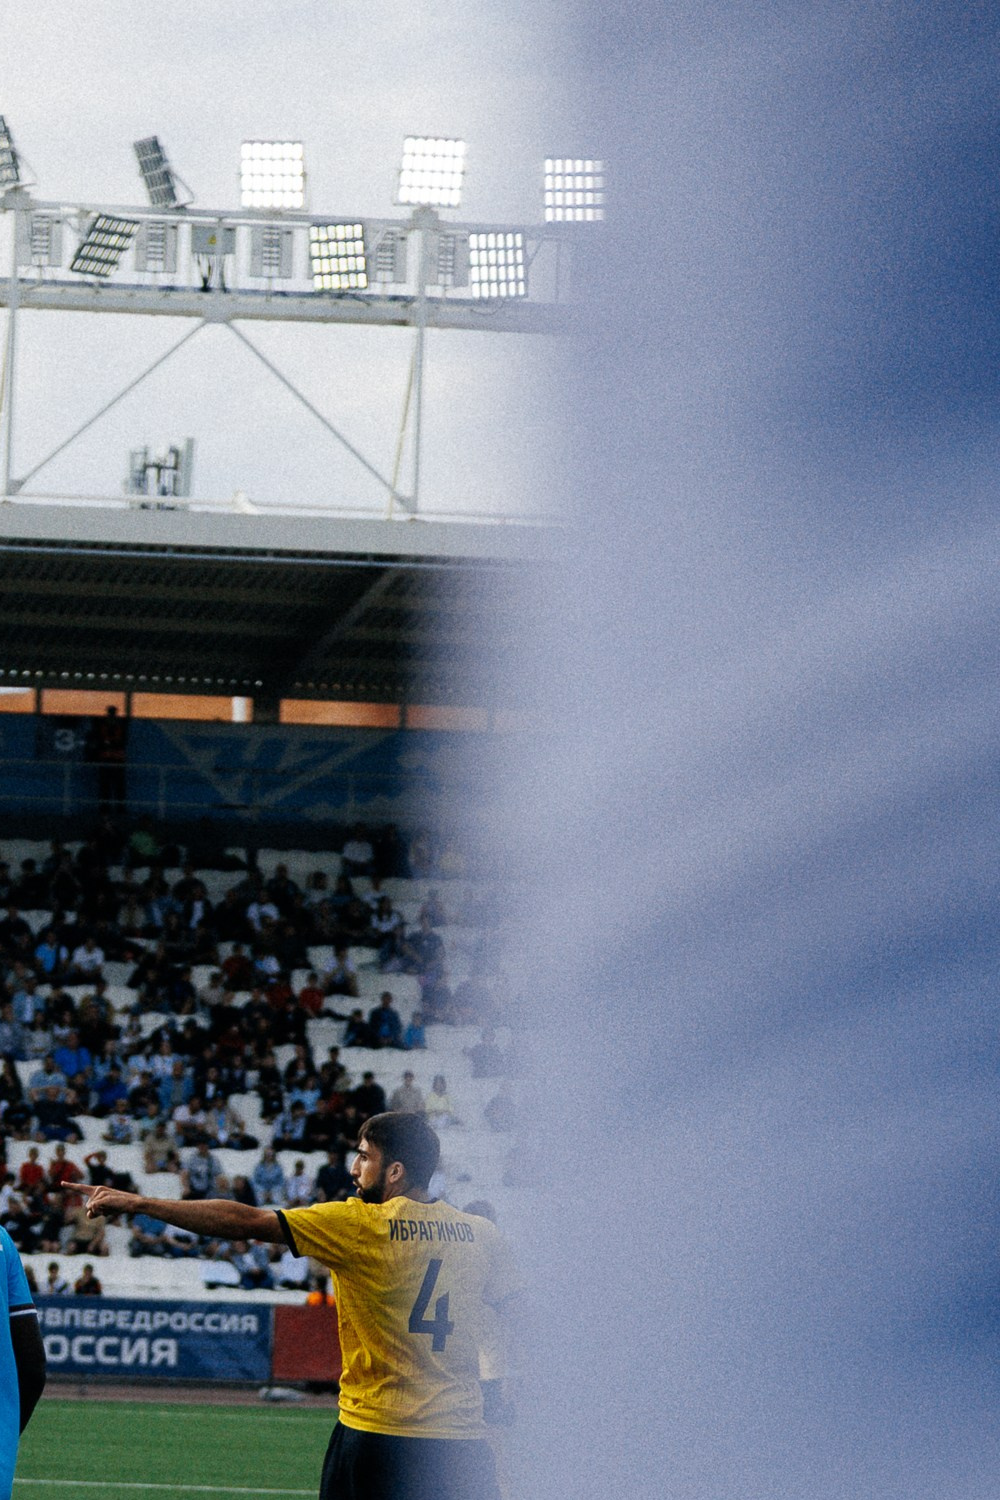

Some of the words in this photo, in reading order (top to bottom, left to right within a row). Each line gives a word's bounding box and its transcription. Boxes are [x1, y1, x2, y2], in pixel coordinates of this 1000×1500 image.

[388, 1219, 475, 1242] ИБРАГИМОВ
[408, 1259, 455, 1352] 4
[43, 1333, 178, 1367] ОССИЯ
